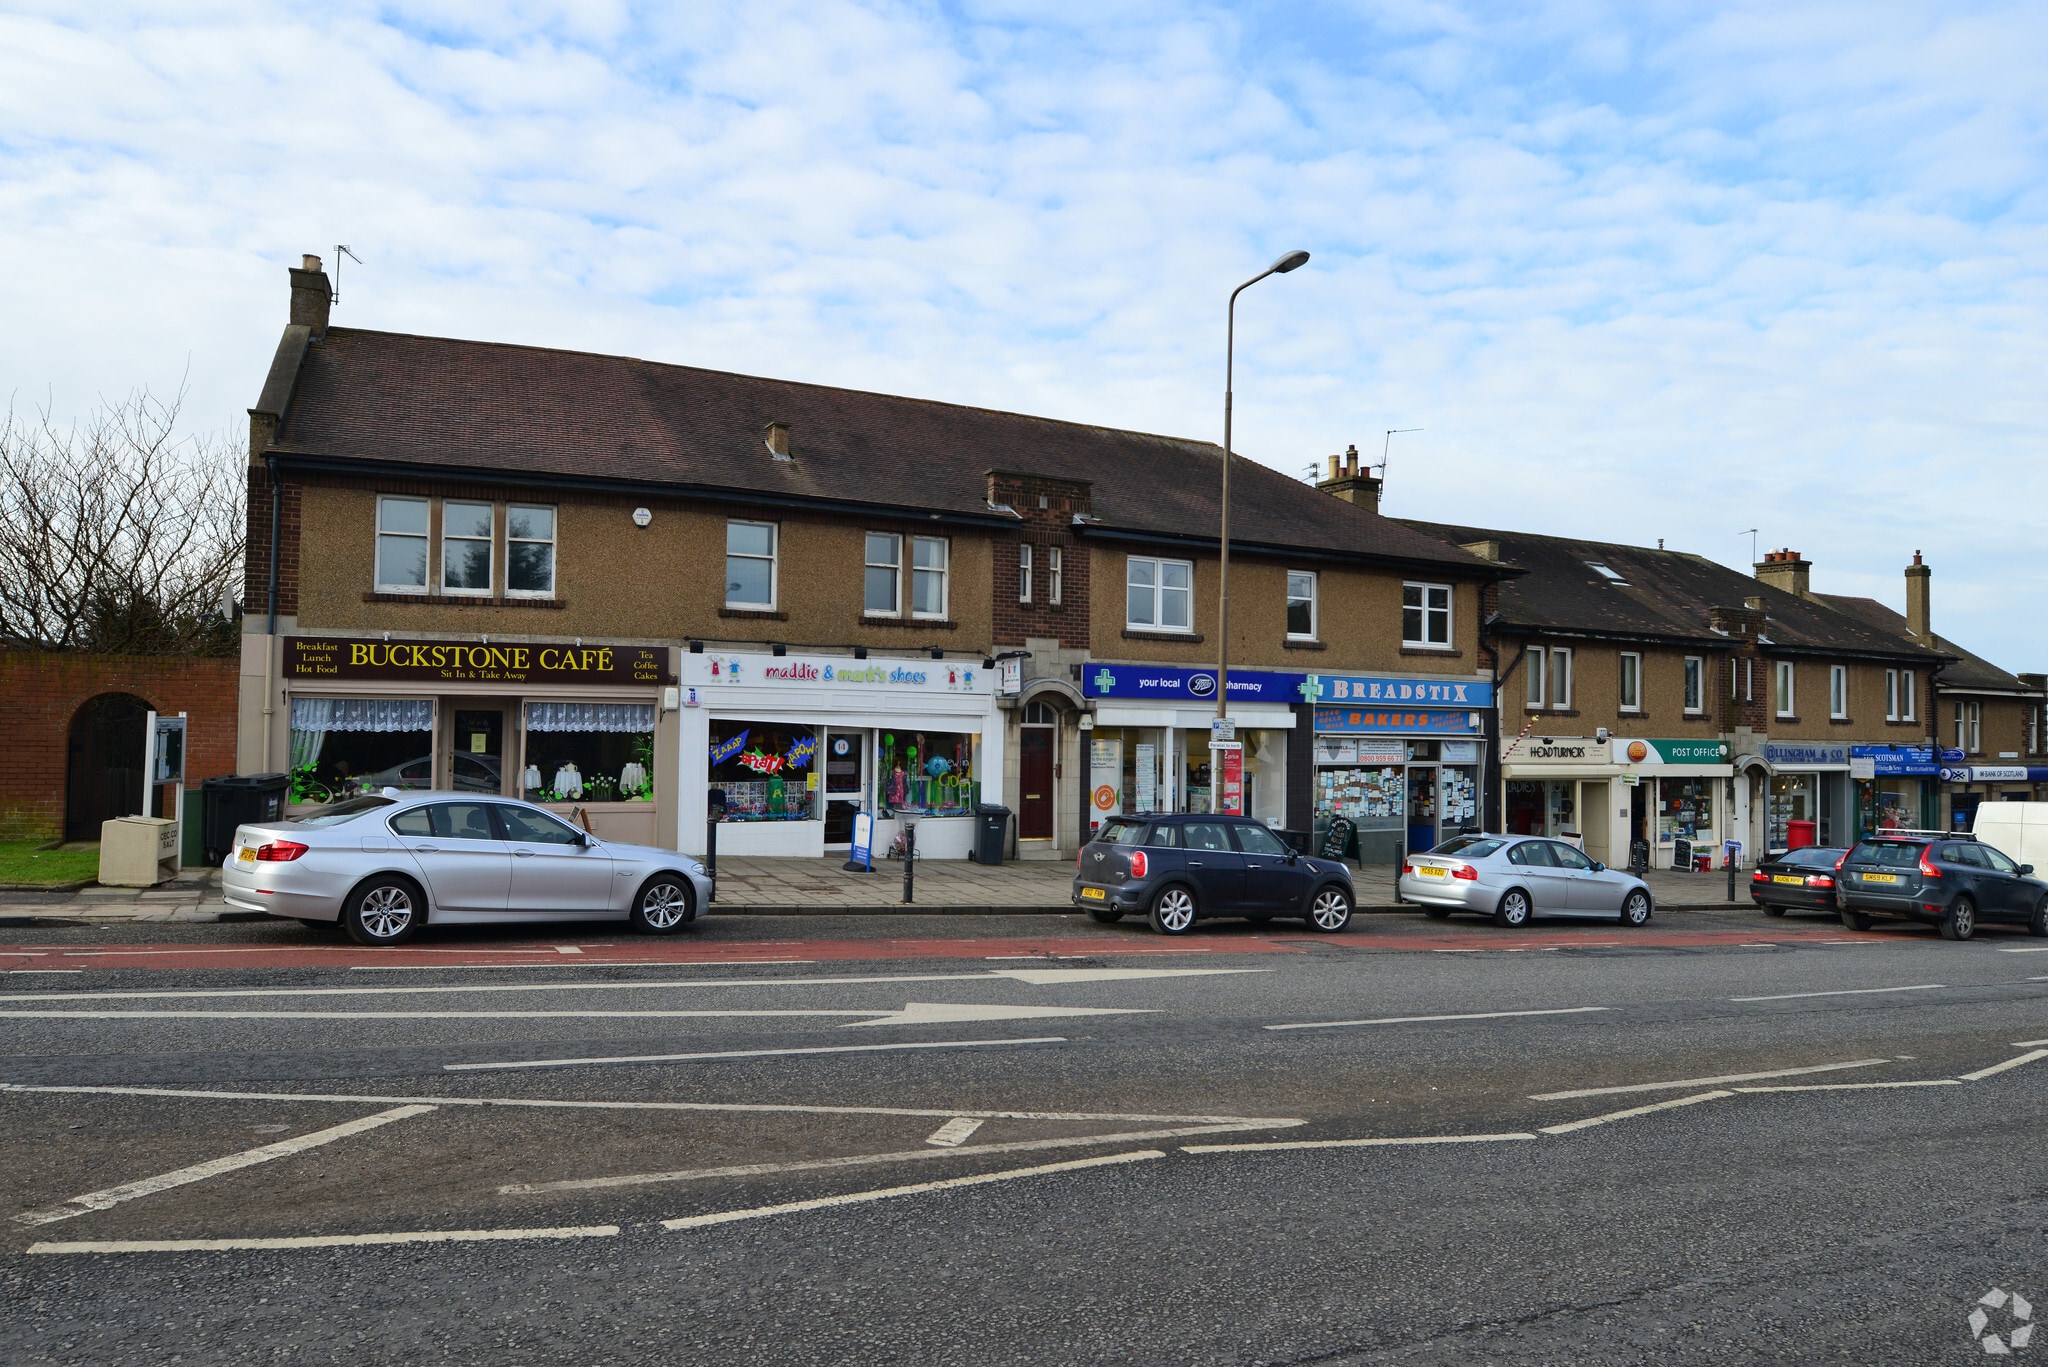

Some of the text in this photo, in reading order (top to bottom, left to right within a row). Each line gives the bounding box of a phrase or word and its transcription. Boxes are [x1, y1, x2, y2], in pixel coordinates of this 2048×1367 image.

[296, 641, 338, 651] Breakfast
[303, 653, 331, 662] Lunch
[349, 643, 614, 671] BUCKSTONE CAFÉ
[639, 650, 654, 659] Tea
[296, 664, 338, 673] Hot Food
[633, 661, 659, 669] Coffee
[440, 670, 453, 678] Sit
[456, 670, 466, 678] In
[479, 670, 501, 679] Take
[503, 671, 527, 681] Away
[634, 672, 658, 680] Cakes
[765, 663, 819, 679] maddie
[823, 665, 833, 681] &
[890, 667, 927, 683] shoes
[1139, 678, 1180, 688] your local
[1333, 680, 1468, 702] BREADSTIX
[1349, 713, 1429, 726] BAKERS
[712, 737, 742, 760] ZAAAP
[838, 743, 846, 751] 14
[1530, 746, 1585, 758] HEADTURNERS
[1672, 748, 1720, 757] POST OFFICE
[1821, 749, 1827, 758] &
[1830, 749, 1843, 758] CO
[1875, 754, 1904, 762] SCOTSMAN
[162, 840, 174, 849] SALT
